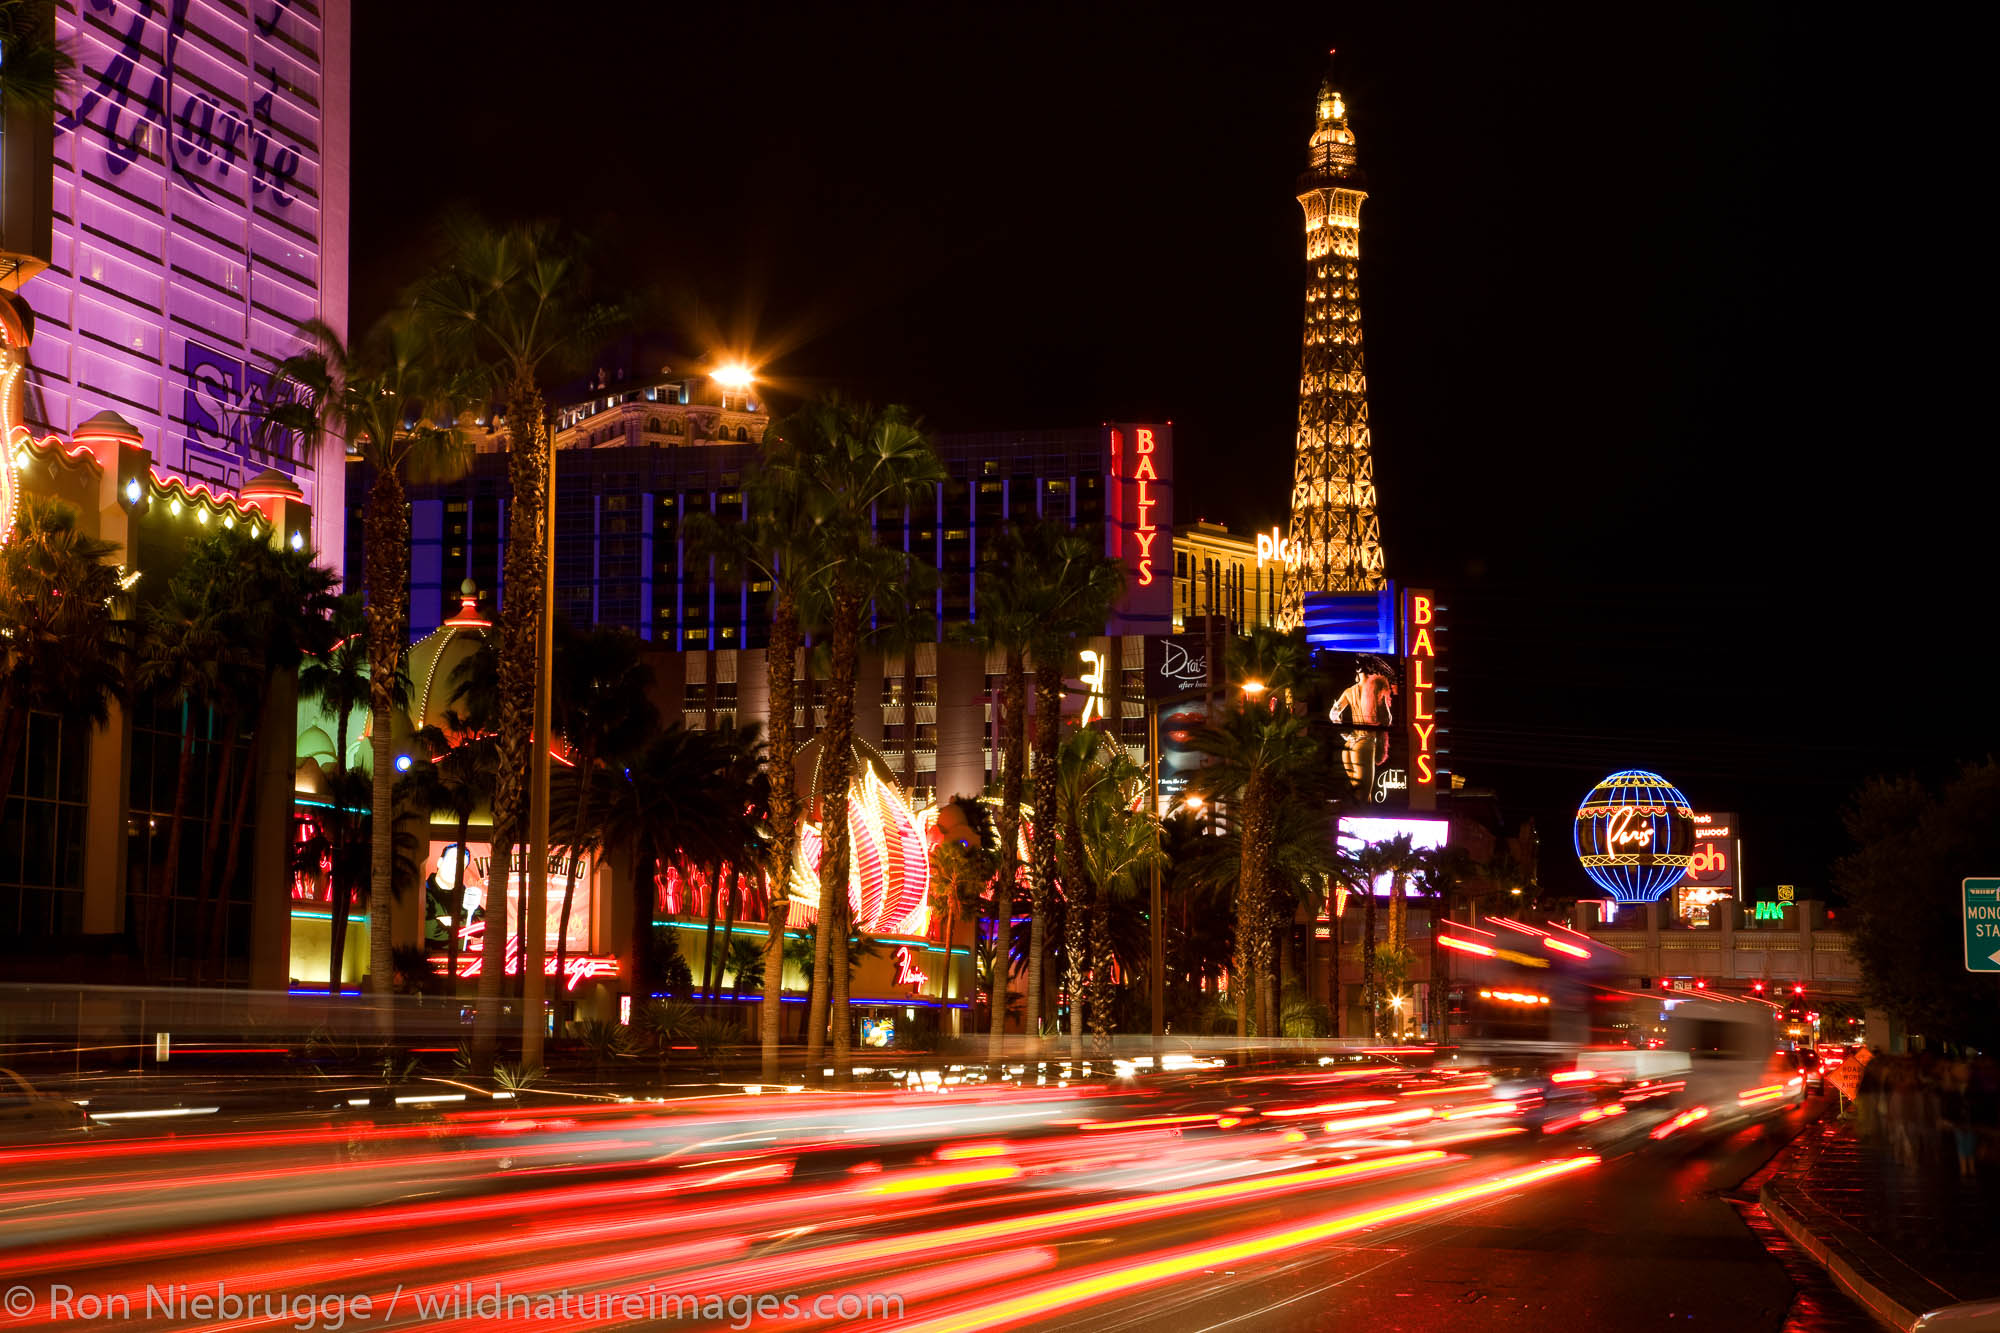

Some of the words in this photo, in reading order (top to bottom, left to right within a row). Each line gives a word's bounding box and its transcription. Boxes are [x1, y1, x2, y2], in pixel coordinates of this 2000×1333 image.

[1134, 429, 1158, 586] BALLYS
[1412, 596, 1435, 784] BALLYS
[1606, 806, 1654, 860] Paris
